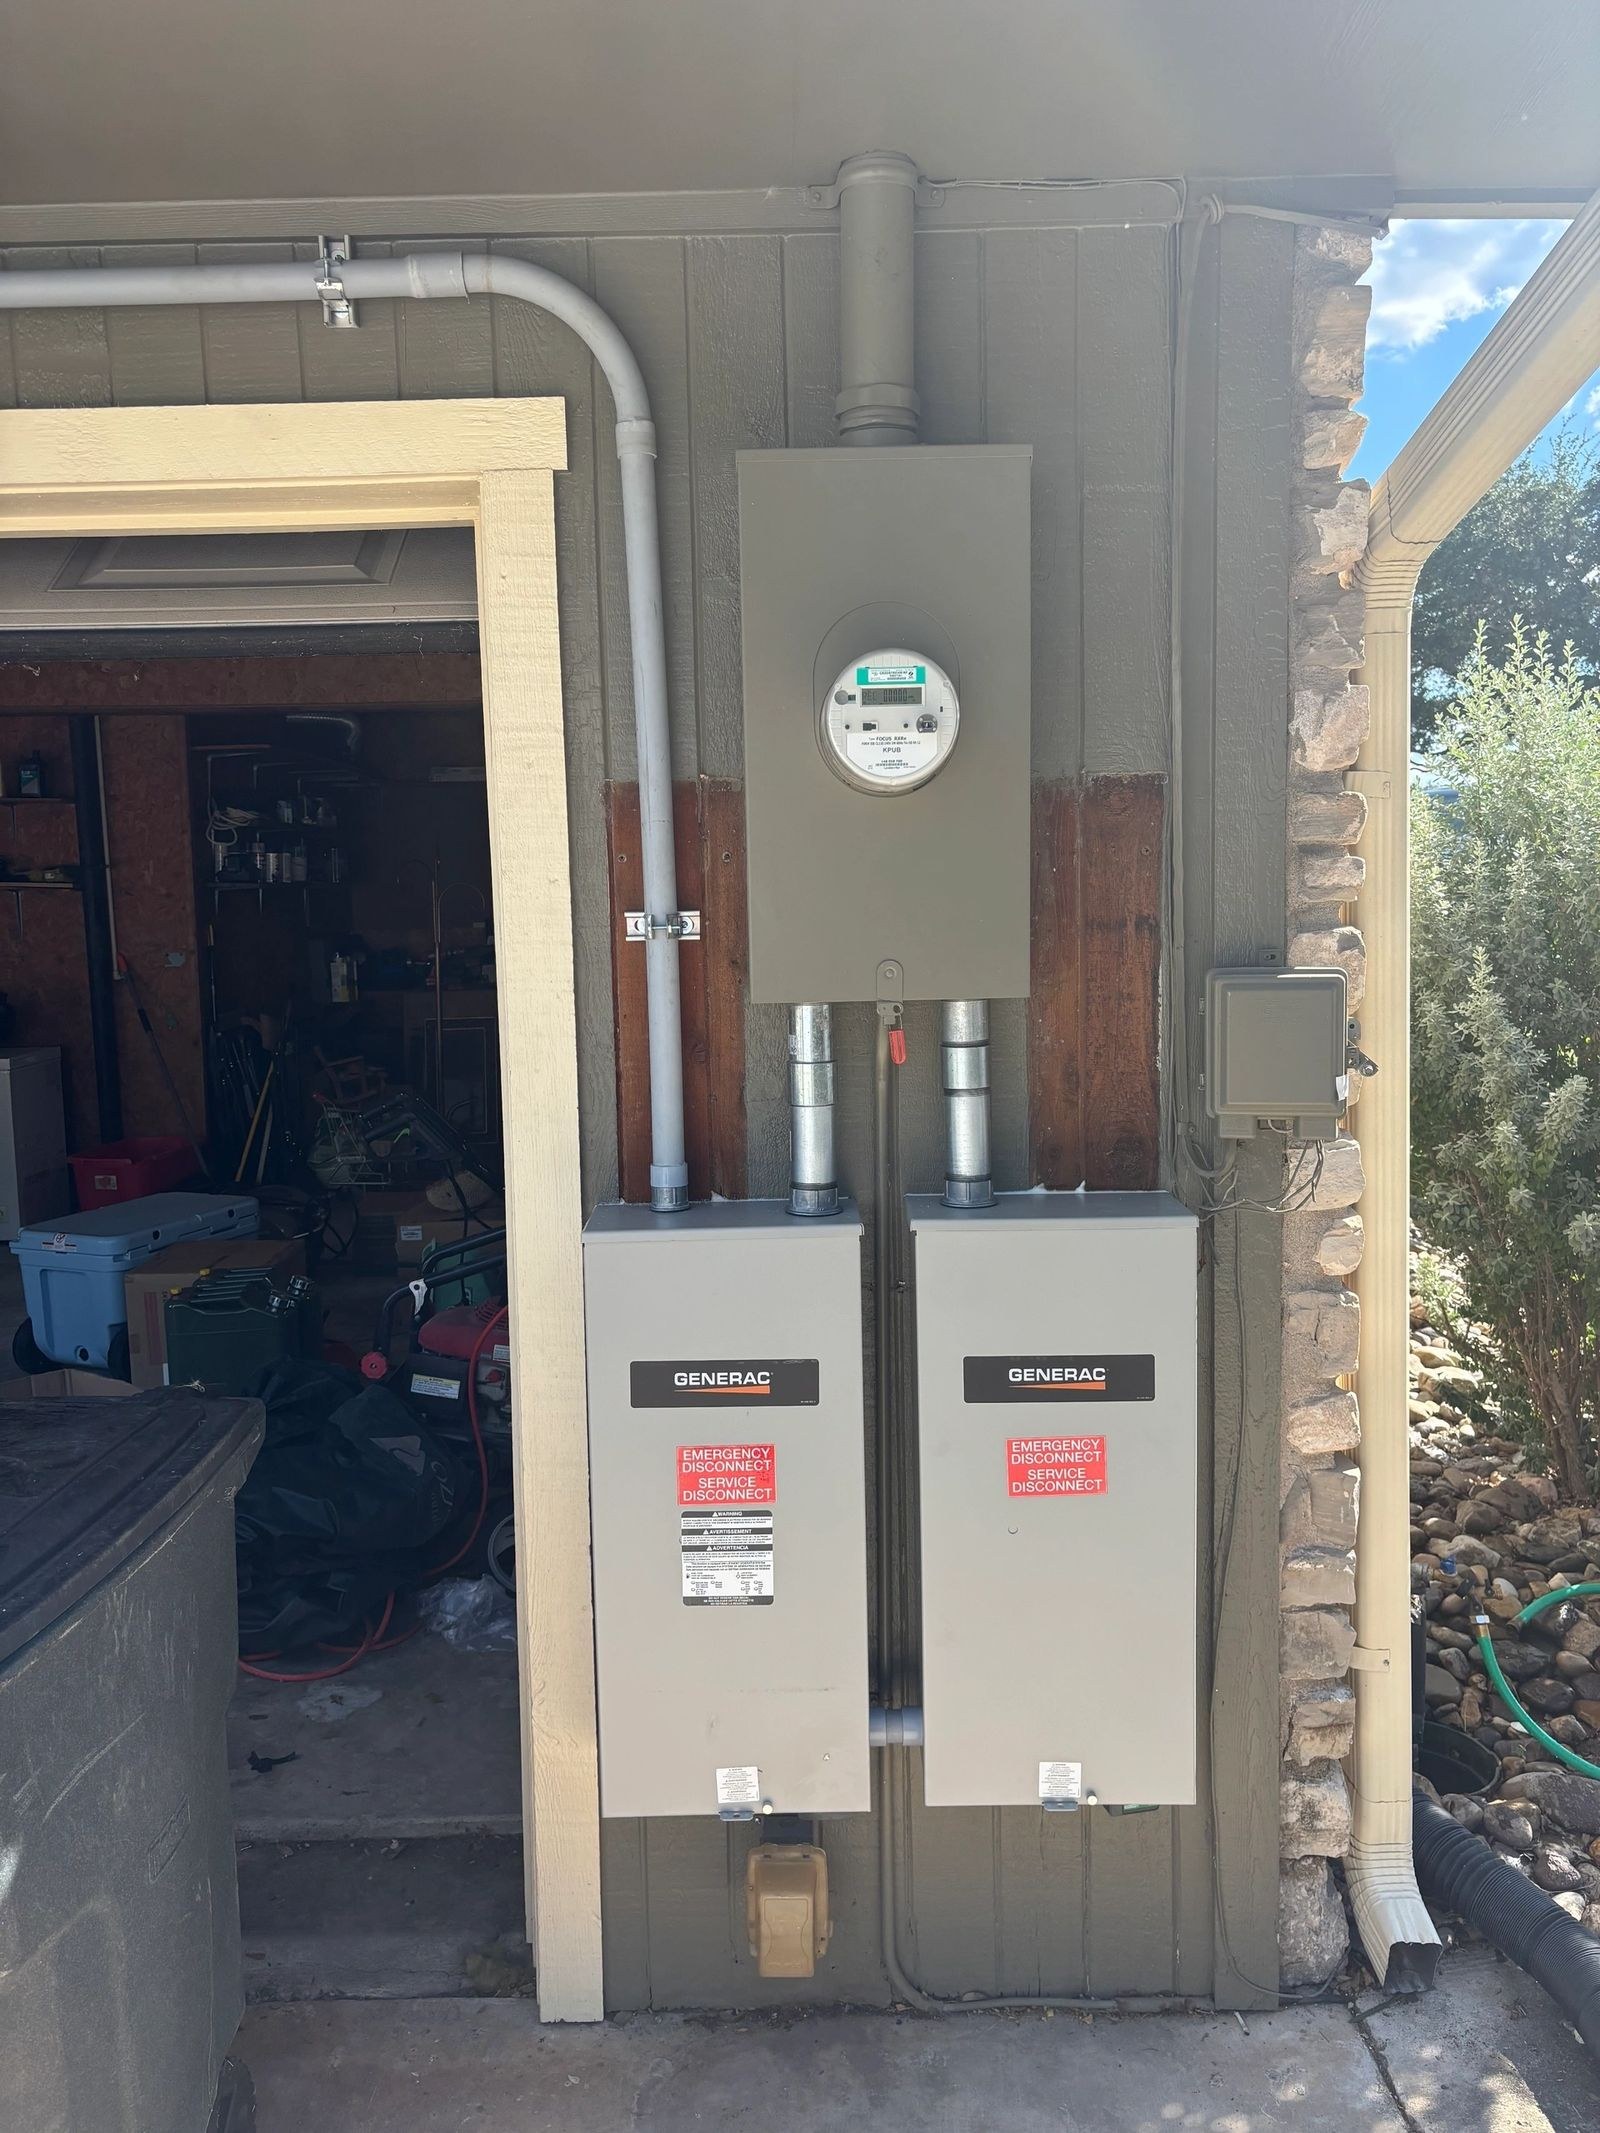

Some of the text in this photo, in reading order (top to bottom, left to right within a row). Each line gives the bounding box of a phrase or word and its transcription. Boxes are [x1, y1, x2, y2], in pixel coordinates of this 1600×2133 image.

[674, 1371, 770, 1386] GENERAC
[1008, 1367, 1106, 1382] GENERAC
[1012, 1439, 1100, 1452] EMERGENCY
[683, 1448, 770, 1461] EMERGENCY
[1011, 1451, 1102, 1464] DISCONNECT
[682, 1460, 772, 1473] DISCONNECT
[1027, 1467, 1086, 1480] SERVICE
[699, 1477, 756, 1489] SERVICE
[1012, 1479, 1103, 1493] DISCONNECT
[683, 1488, 773, 1501] DISCONNECT
